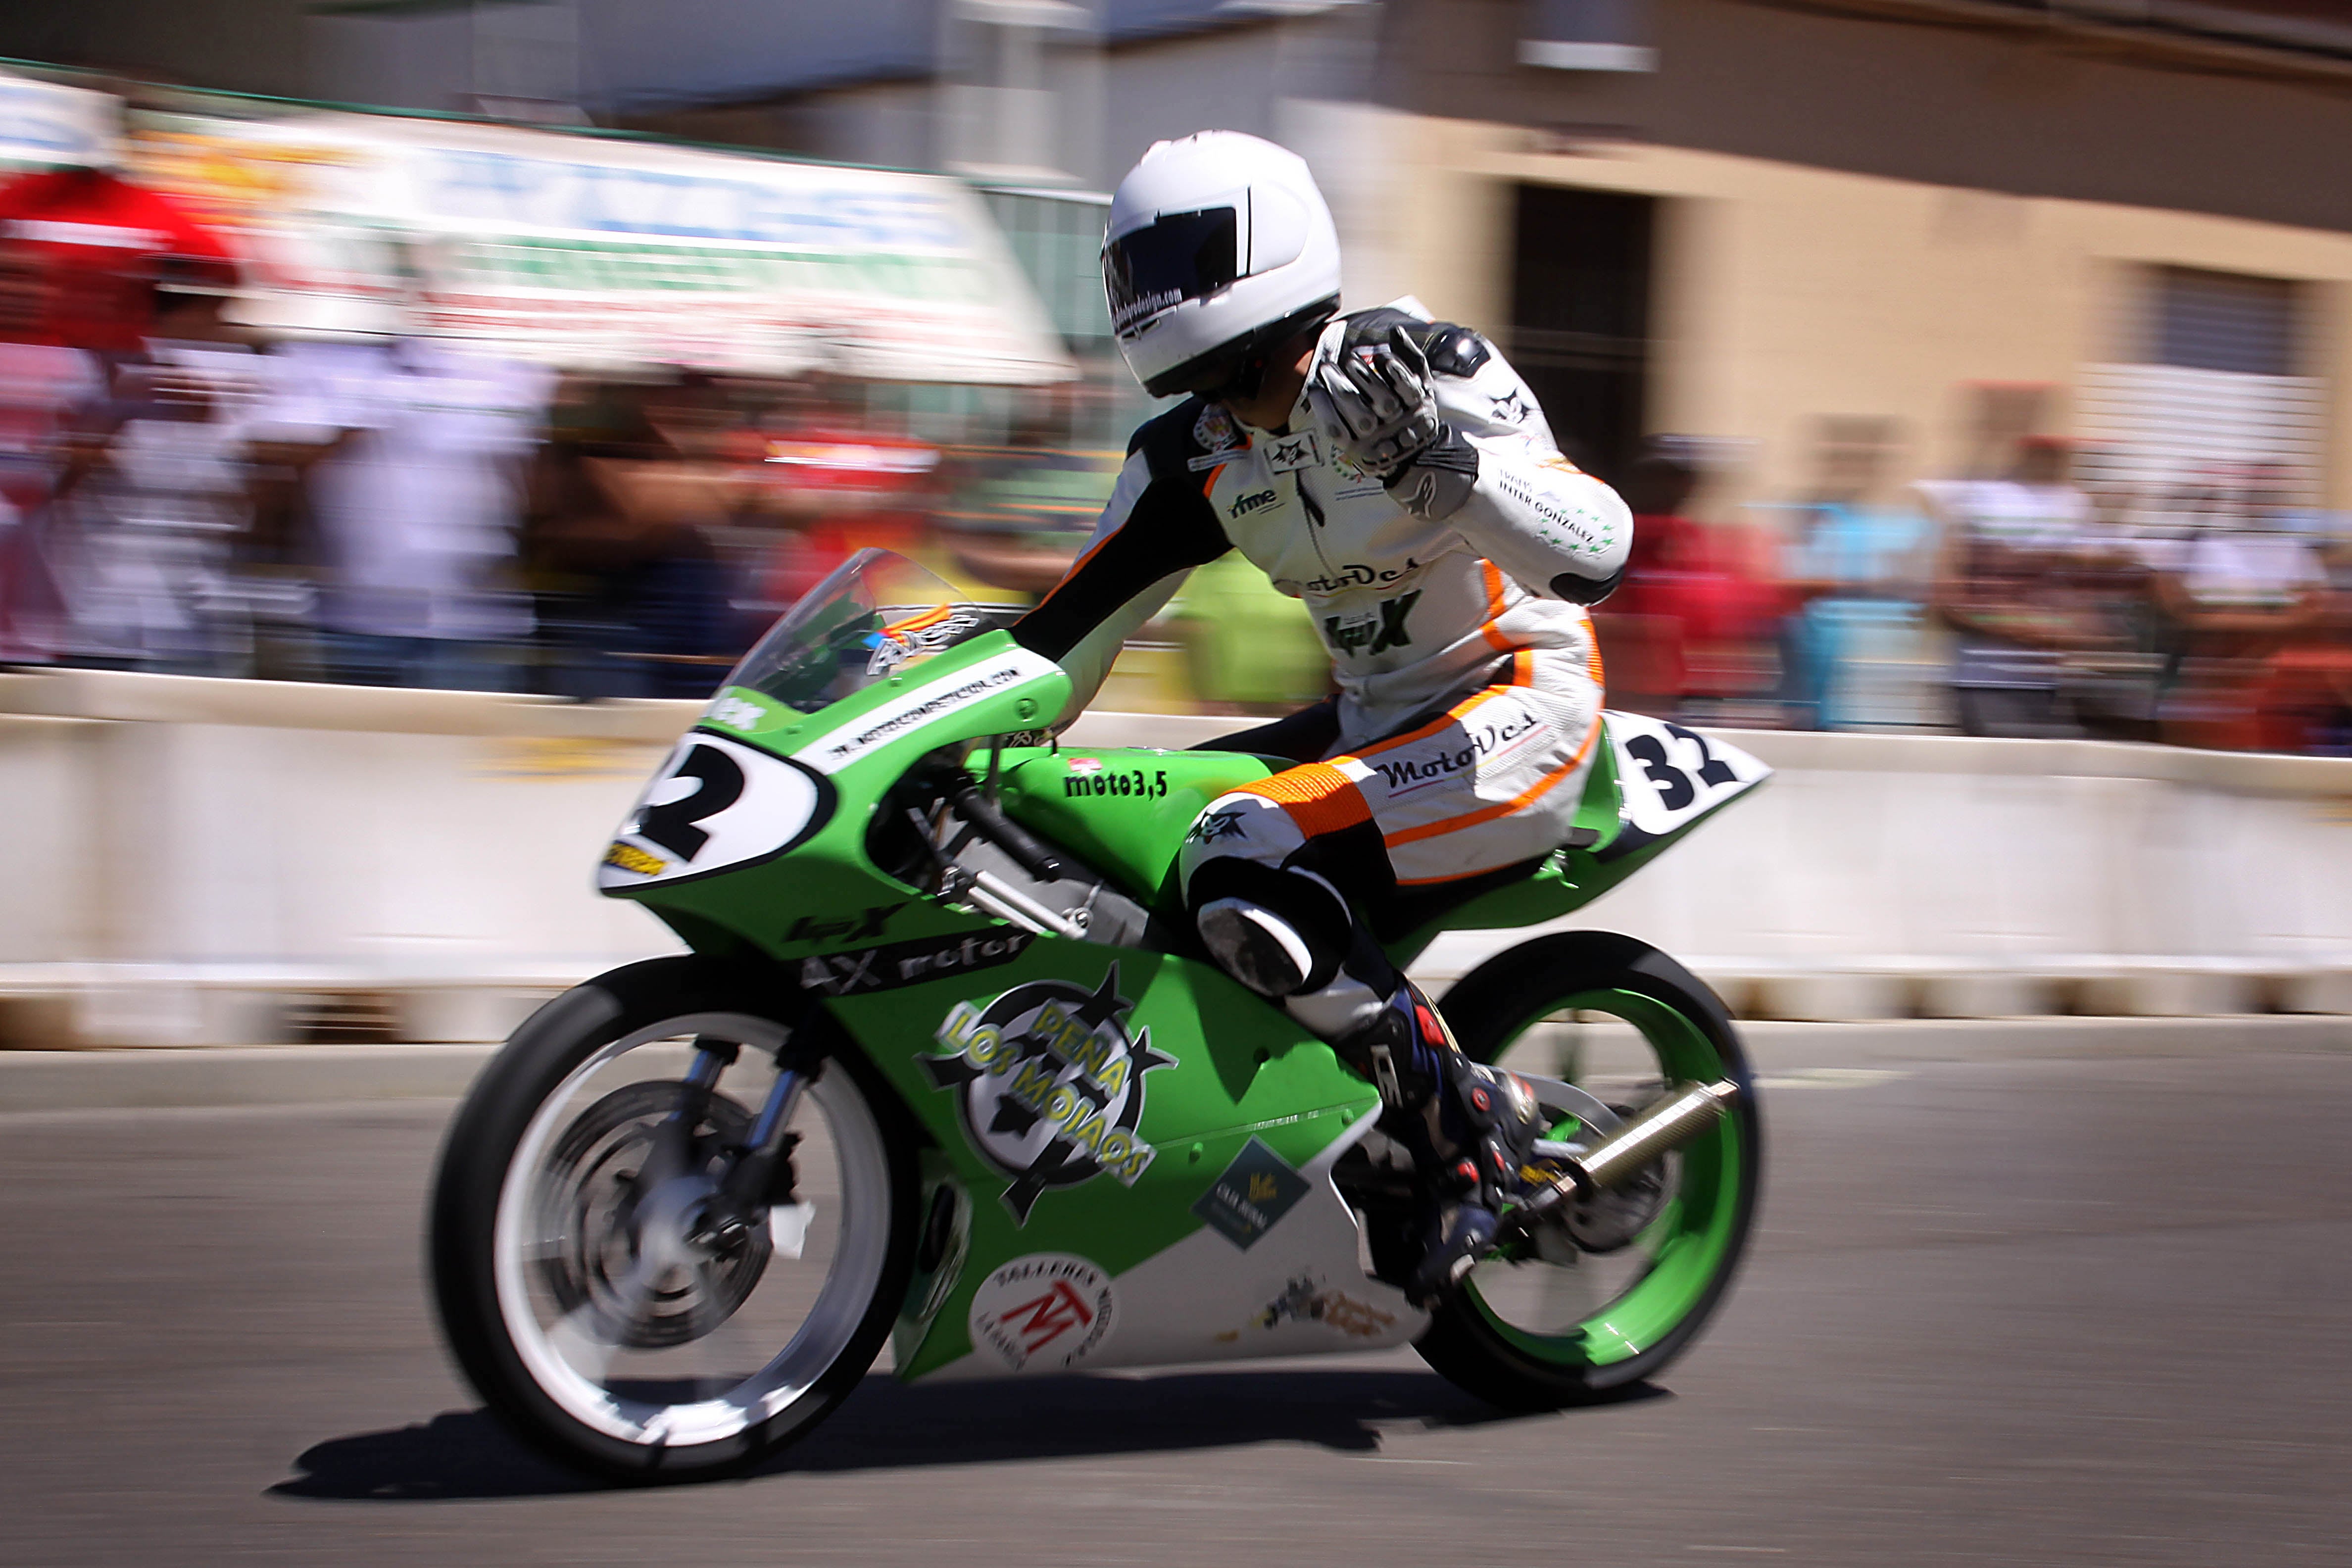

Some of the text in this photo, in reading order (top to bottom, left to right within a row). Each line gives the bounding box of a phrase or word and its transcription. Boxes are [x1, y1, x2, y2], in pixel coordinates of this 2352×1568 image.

[1534, 501, 1596, 542] GONZALEZ
[1064, 770, 1168, 801] moto3,5
[1625, 723, 1738, 811] 32
[897, 933, 1029, 980] motor
[944, 1011, 1020, 1072] LOS
